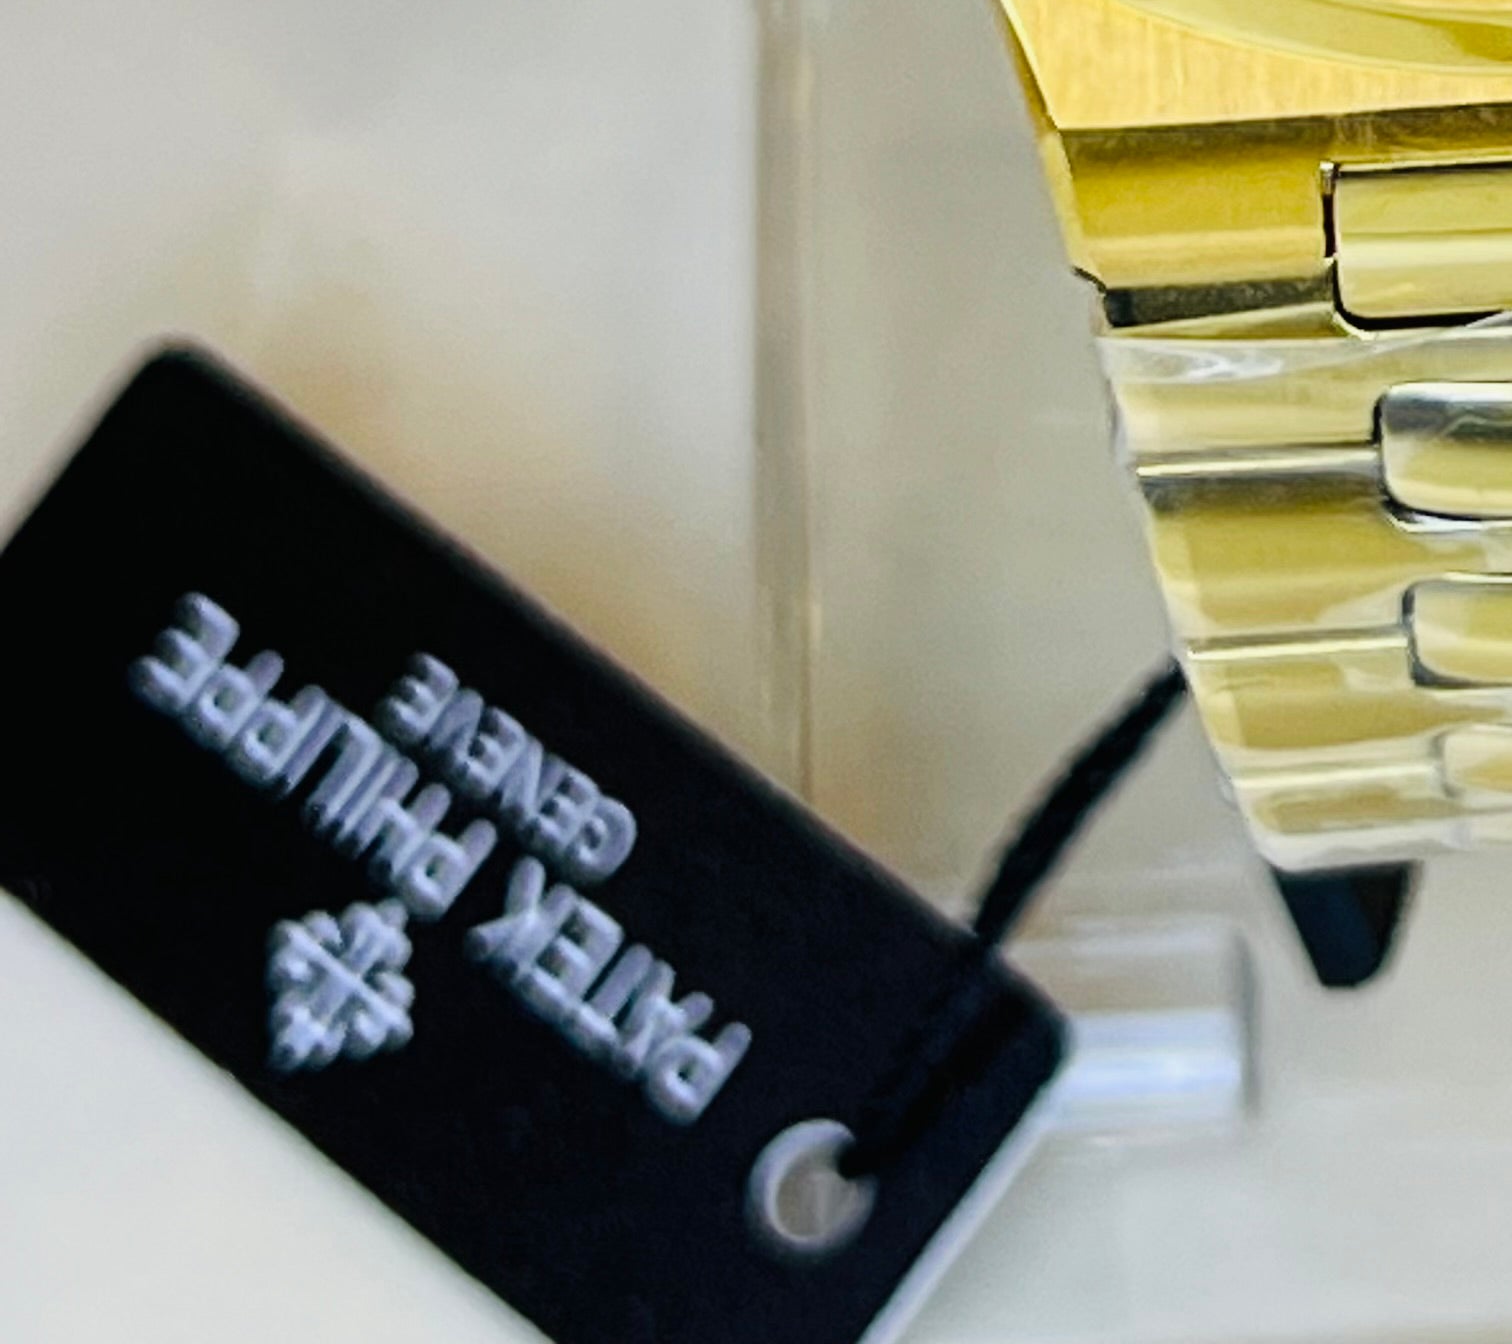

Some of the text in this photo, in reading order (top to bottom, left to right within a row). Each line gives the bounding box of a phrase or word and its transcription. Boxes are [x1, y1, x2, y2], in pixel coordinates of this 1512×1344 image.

[131, 591, 752, 1123] PATEK PHILIPPE
[380, 651, 638, 882] GENEVE
